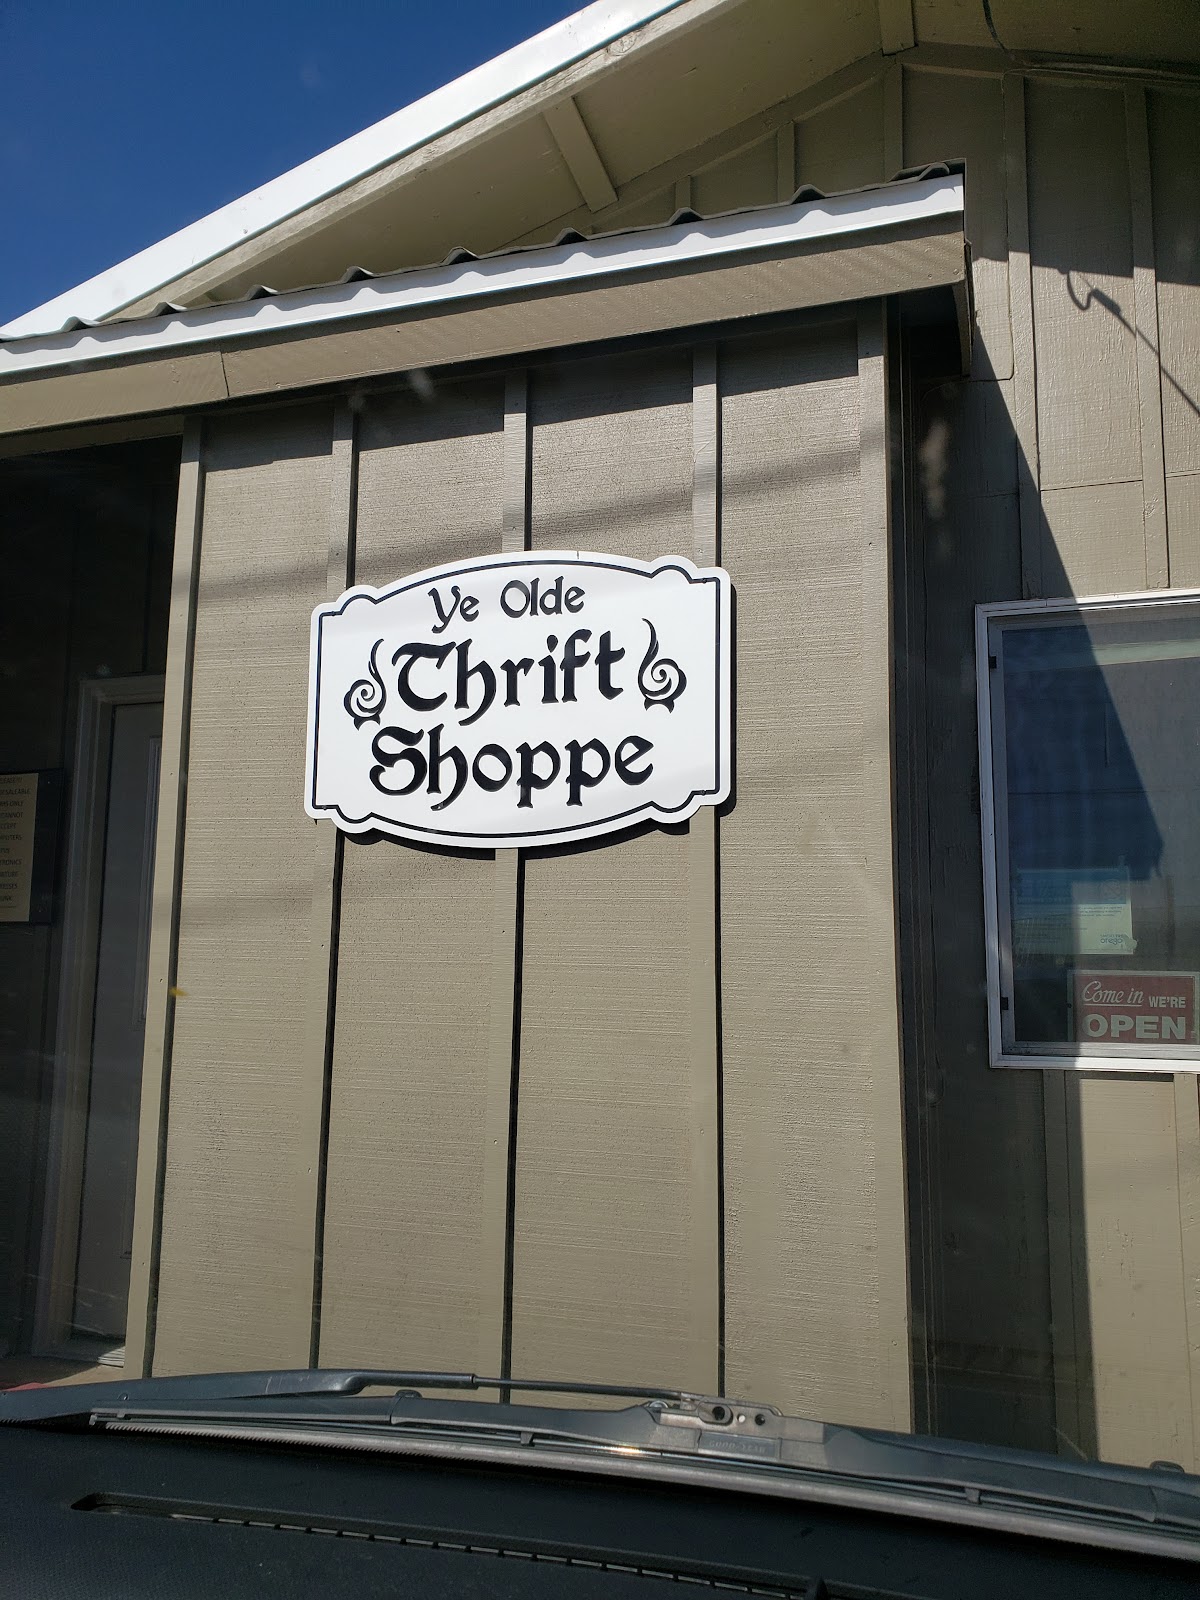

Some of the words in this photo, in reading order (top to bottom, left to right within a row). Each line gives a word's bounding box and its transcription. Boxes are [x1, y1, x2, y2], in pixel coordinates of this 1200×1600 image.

[428, 585, 480, 634] Ye
[500, 575, 586, 618] Olde
[391, 628, 626, 726] Thrift
[369, 723, 654, 811] Shoppe
[1082, 980, 1124, 1003] Come
[1127, 988, 1144, 1004] in
[1148, 996, 1187, 1009] WE'RE
[1082, 1013, 1186, 1039] OPEN
